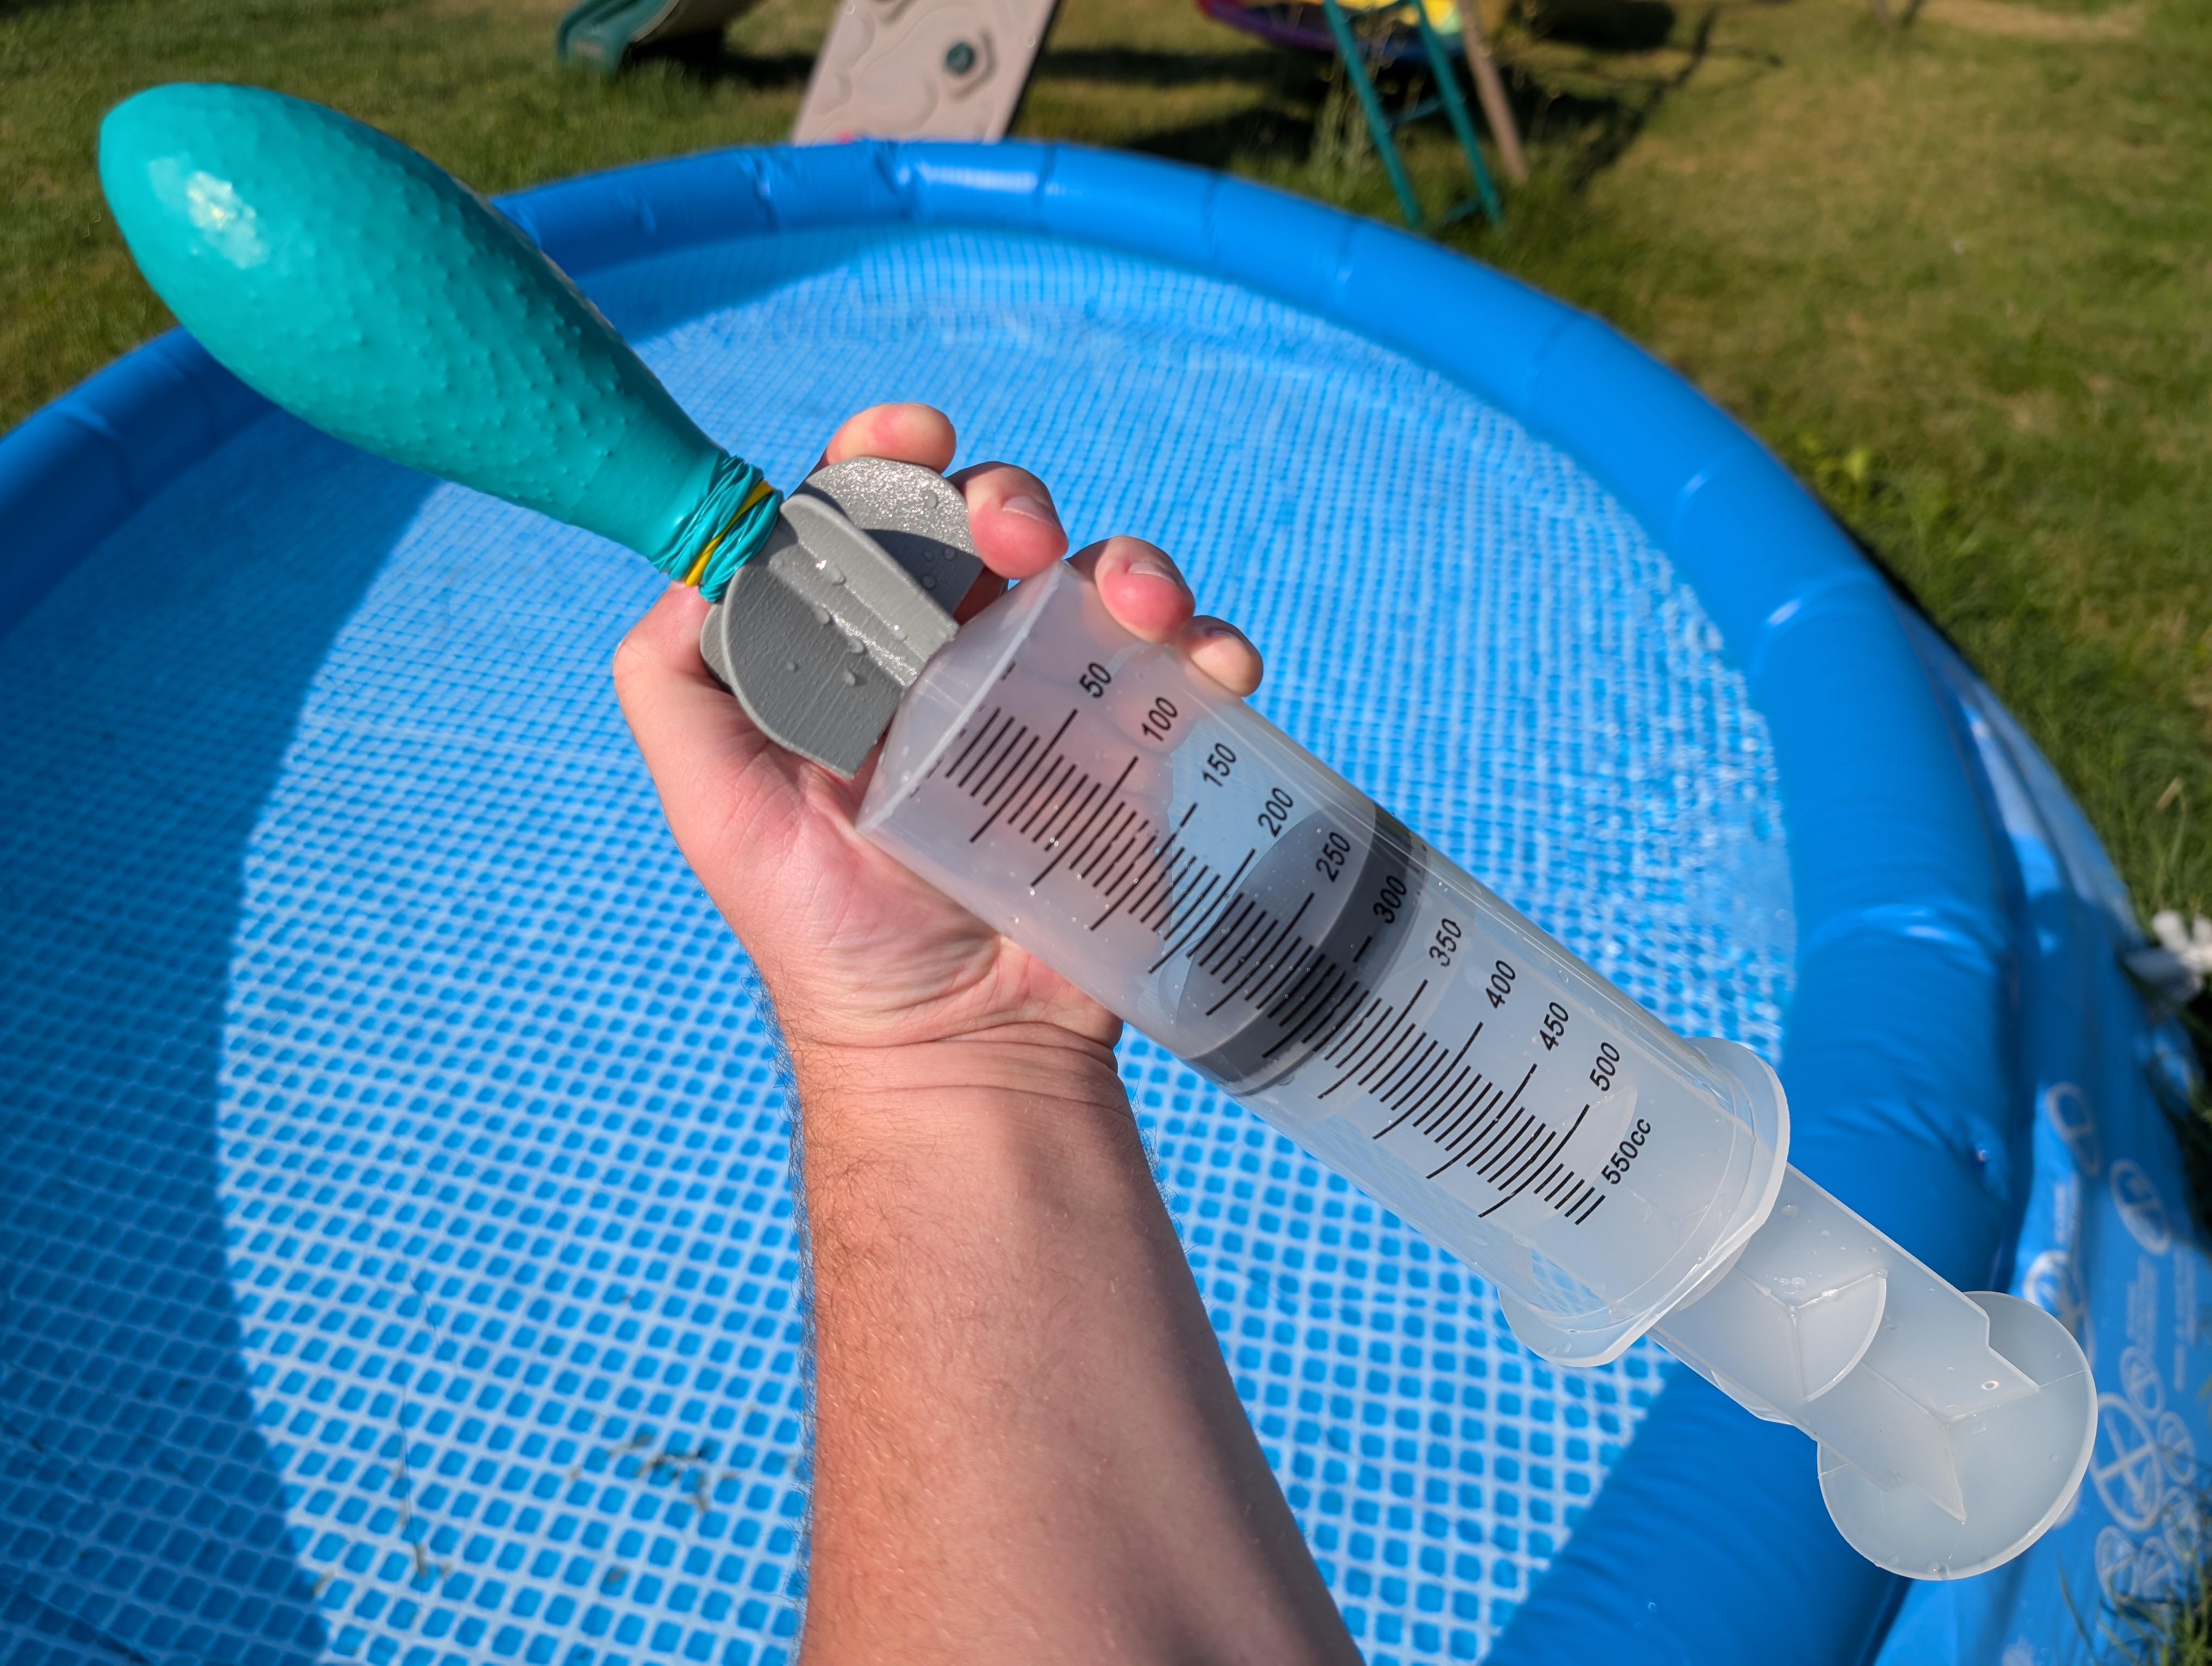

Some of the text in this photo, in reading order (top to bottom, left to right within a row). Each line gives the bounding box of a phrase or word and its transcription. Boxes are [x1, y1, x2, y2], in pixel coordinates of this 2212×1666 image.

[1080, 663, 1111, 698] 50
[1142, 697, 1178, 741] 100
[1203, 743, 1237, 787] 150
[1258, 787, 1293, 837] 200
[1316, 832, 1350, 882] 250
[1373, 875, 1406, 924] 300
[1429, 918, 1461, 966] 350
[1486, 960, 1516, 1008] 400
[1539, 1002, 1569, 1051] 450
[1590, 1042, 1620, 1091] 500
[1601, 1119, 1650, 1184] 550cc
